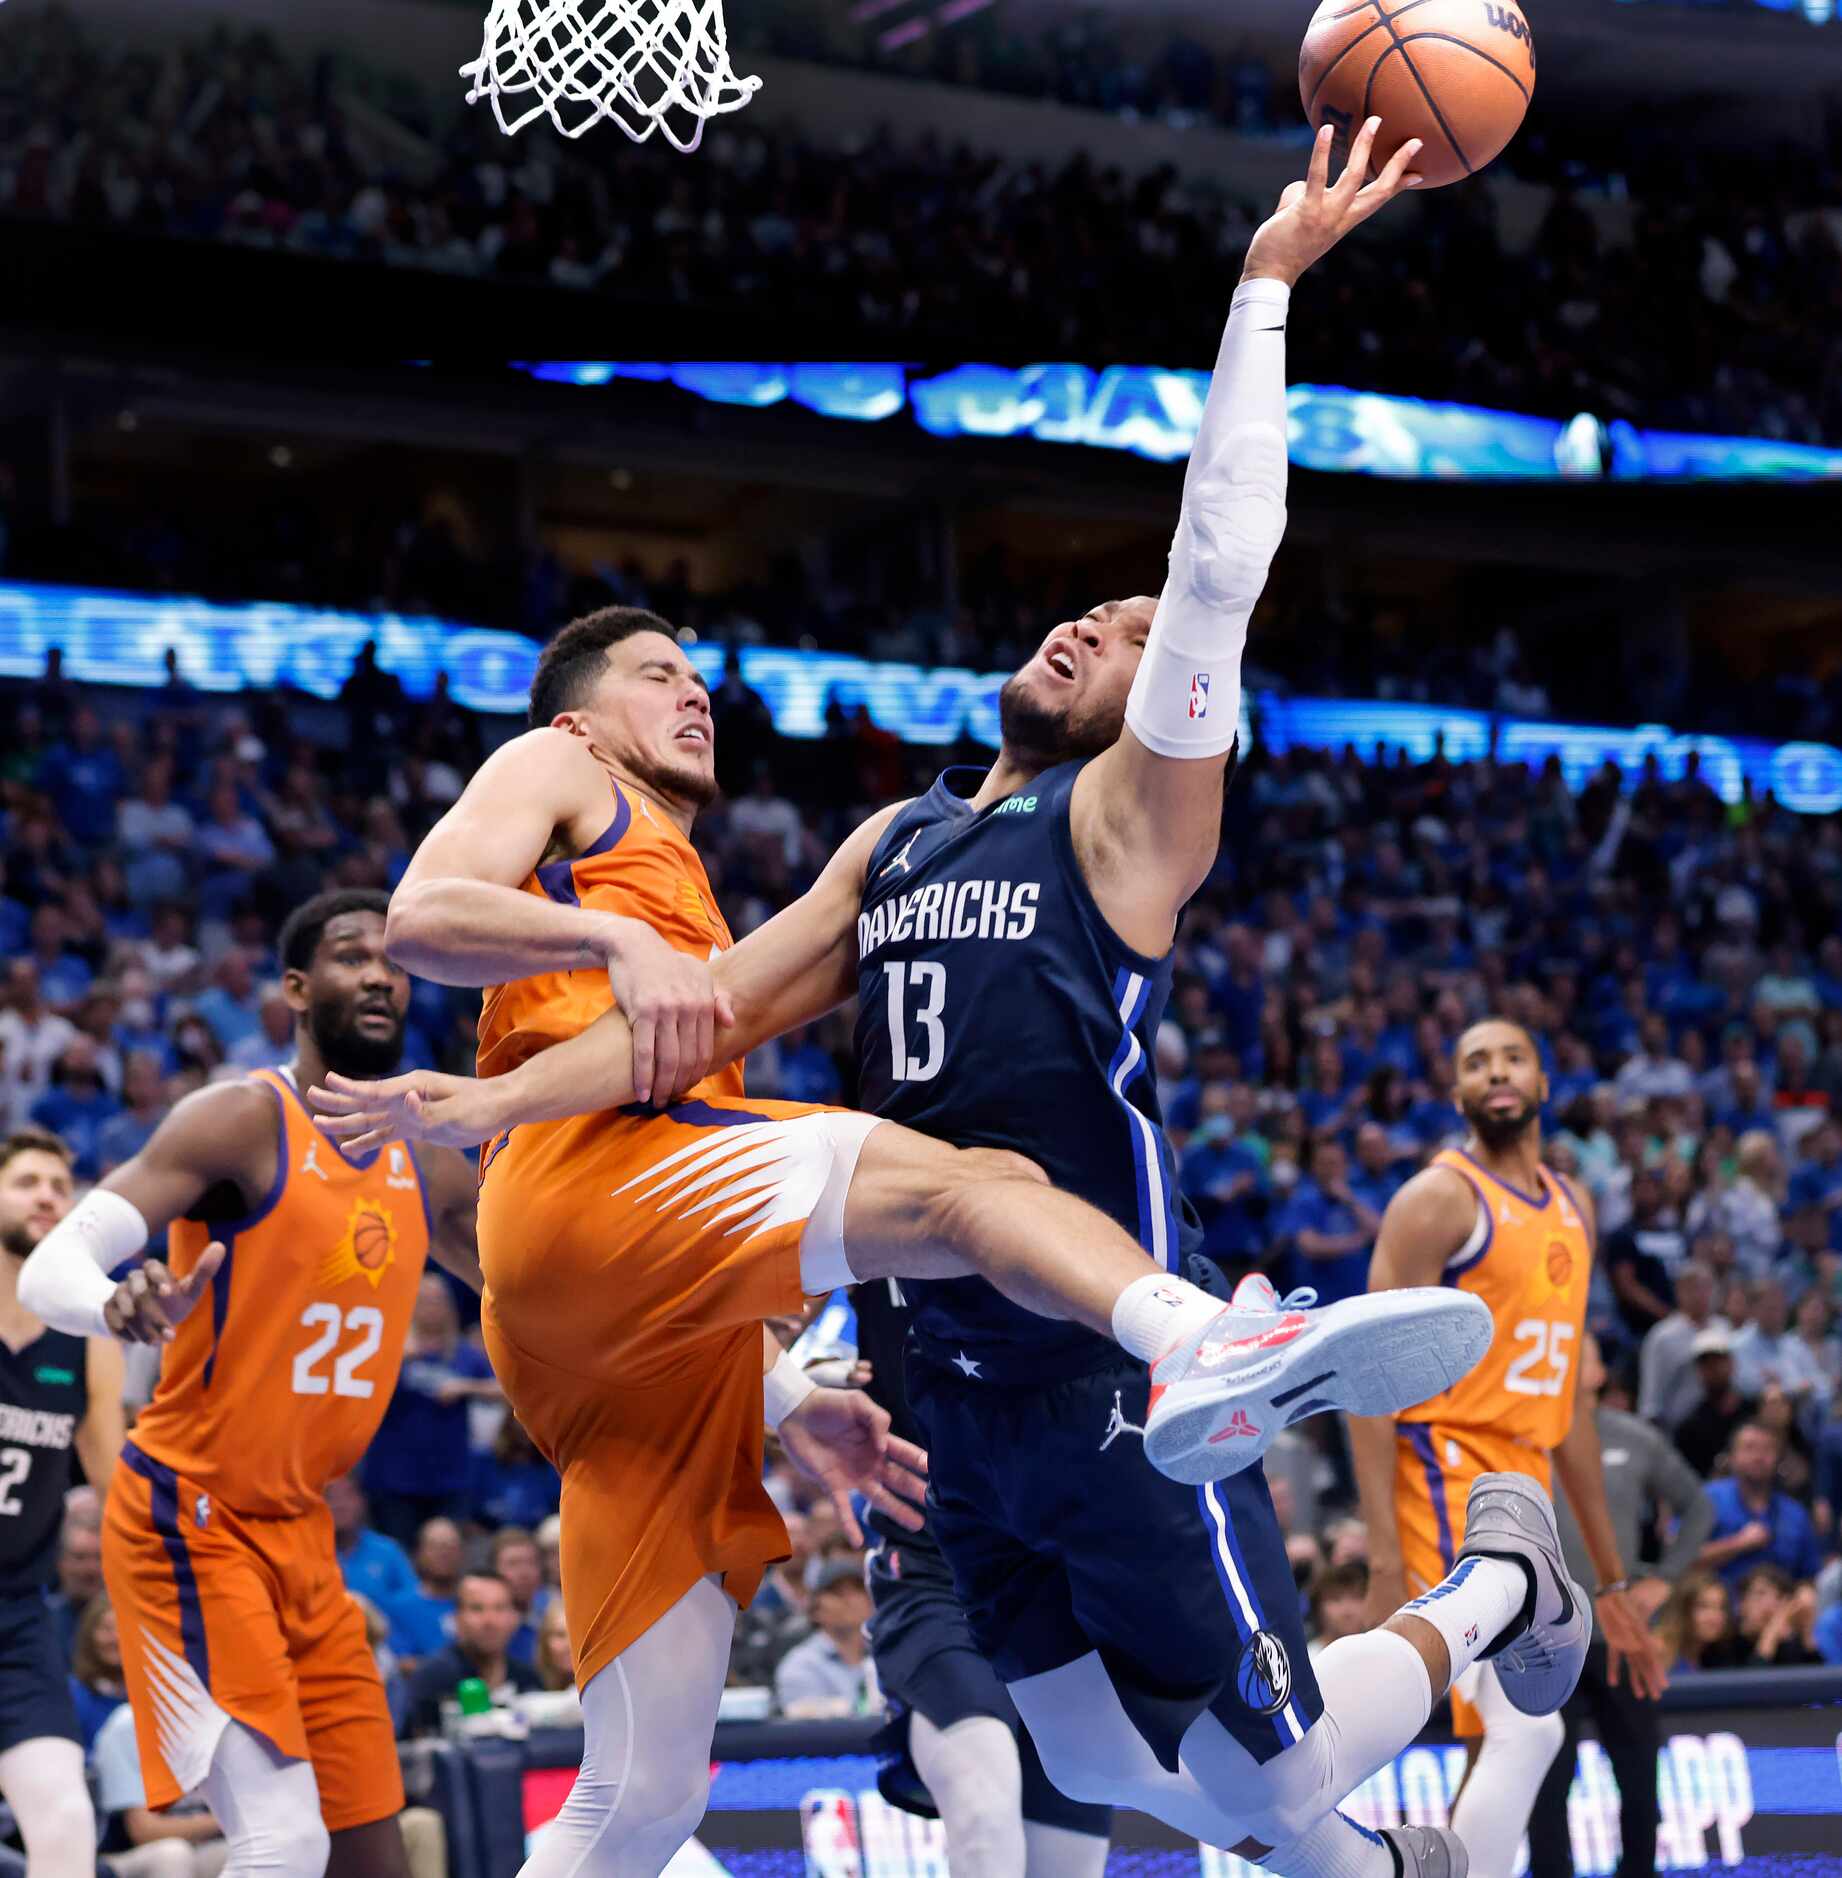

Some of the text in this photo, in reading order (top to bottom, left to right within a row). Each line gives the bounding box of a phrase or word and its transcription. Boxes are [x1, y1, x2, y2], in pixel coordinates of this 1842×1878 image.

[883, 960, 947, 1082] 13
[292, 1301, 384, 1399] 22
[1504, 1318, 1574, 1396] 25
